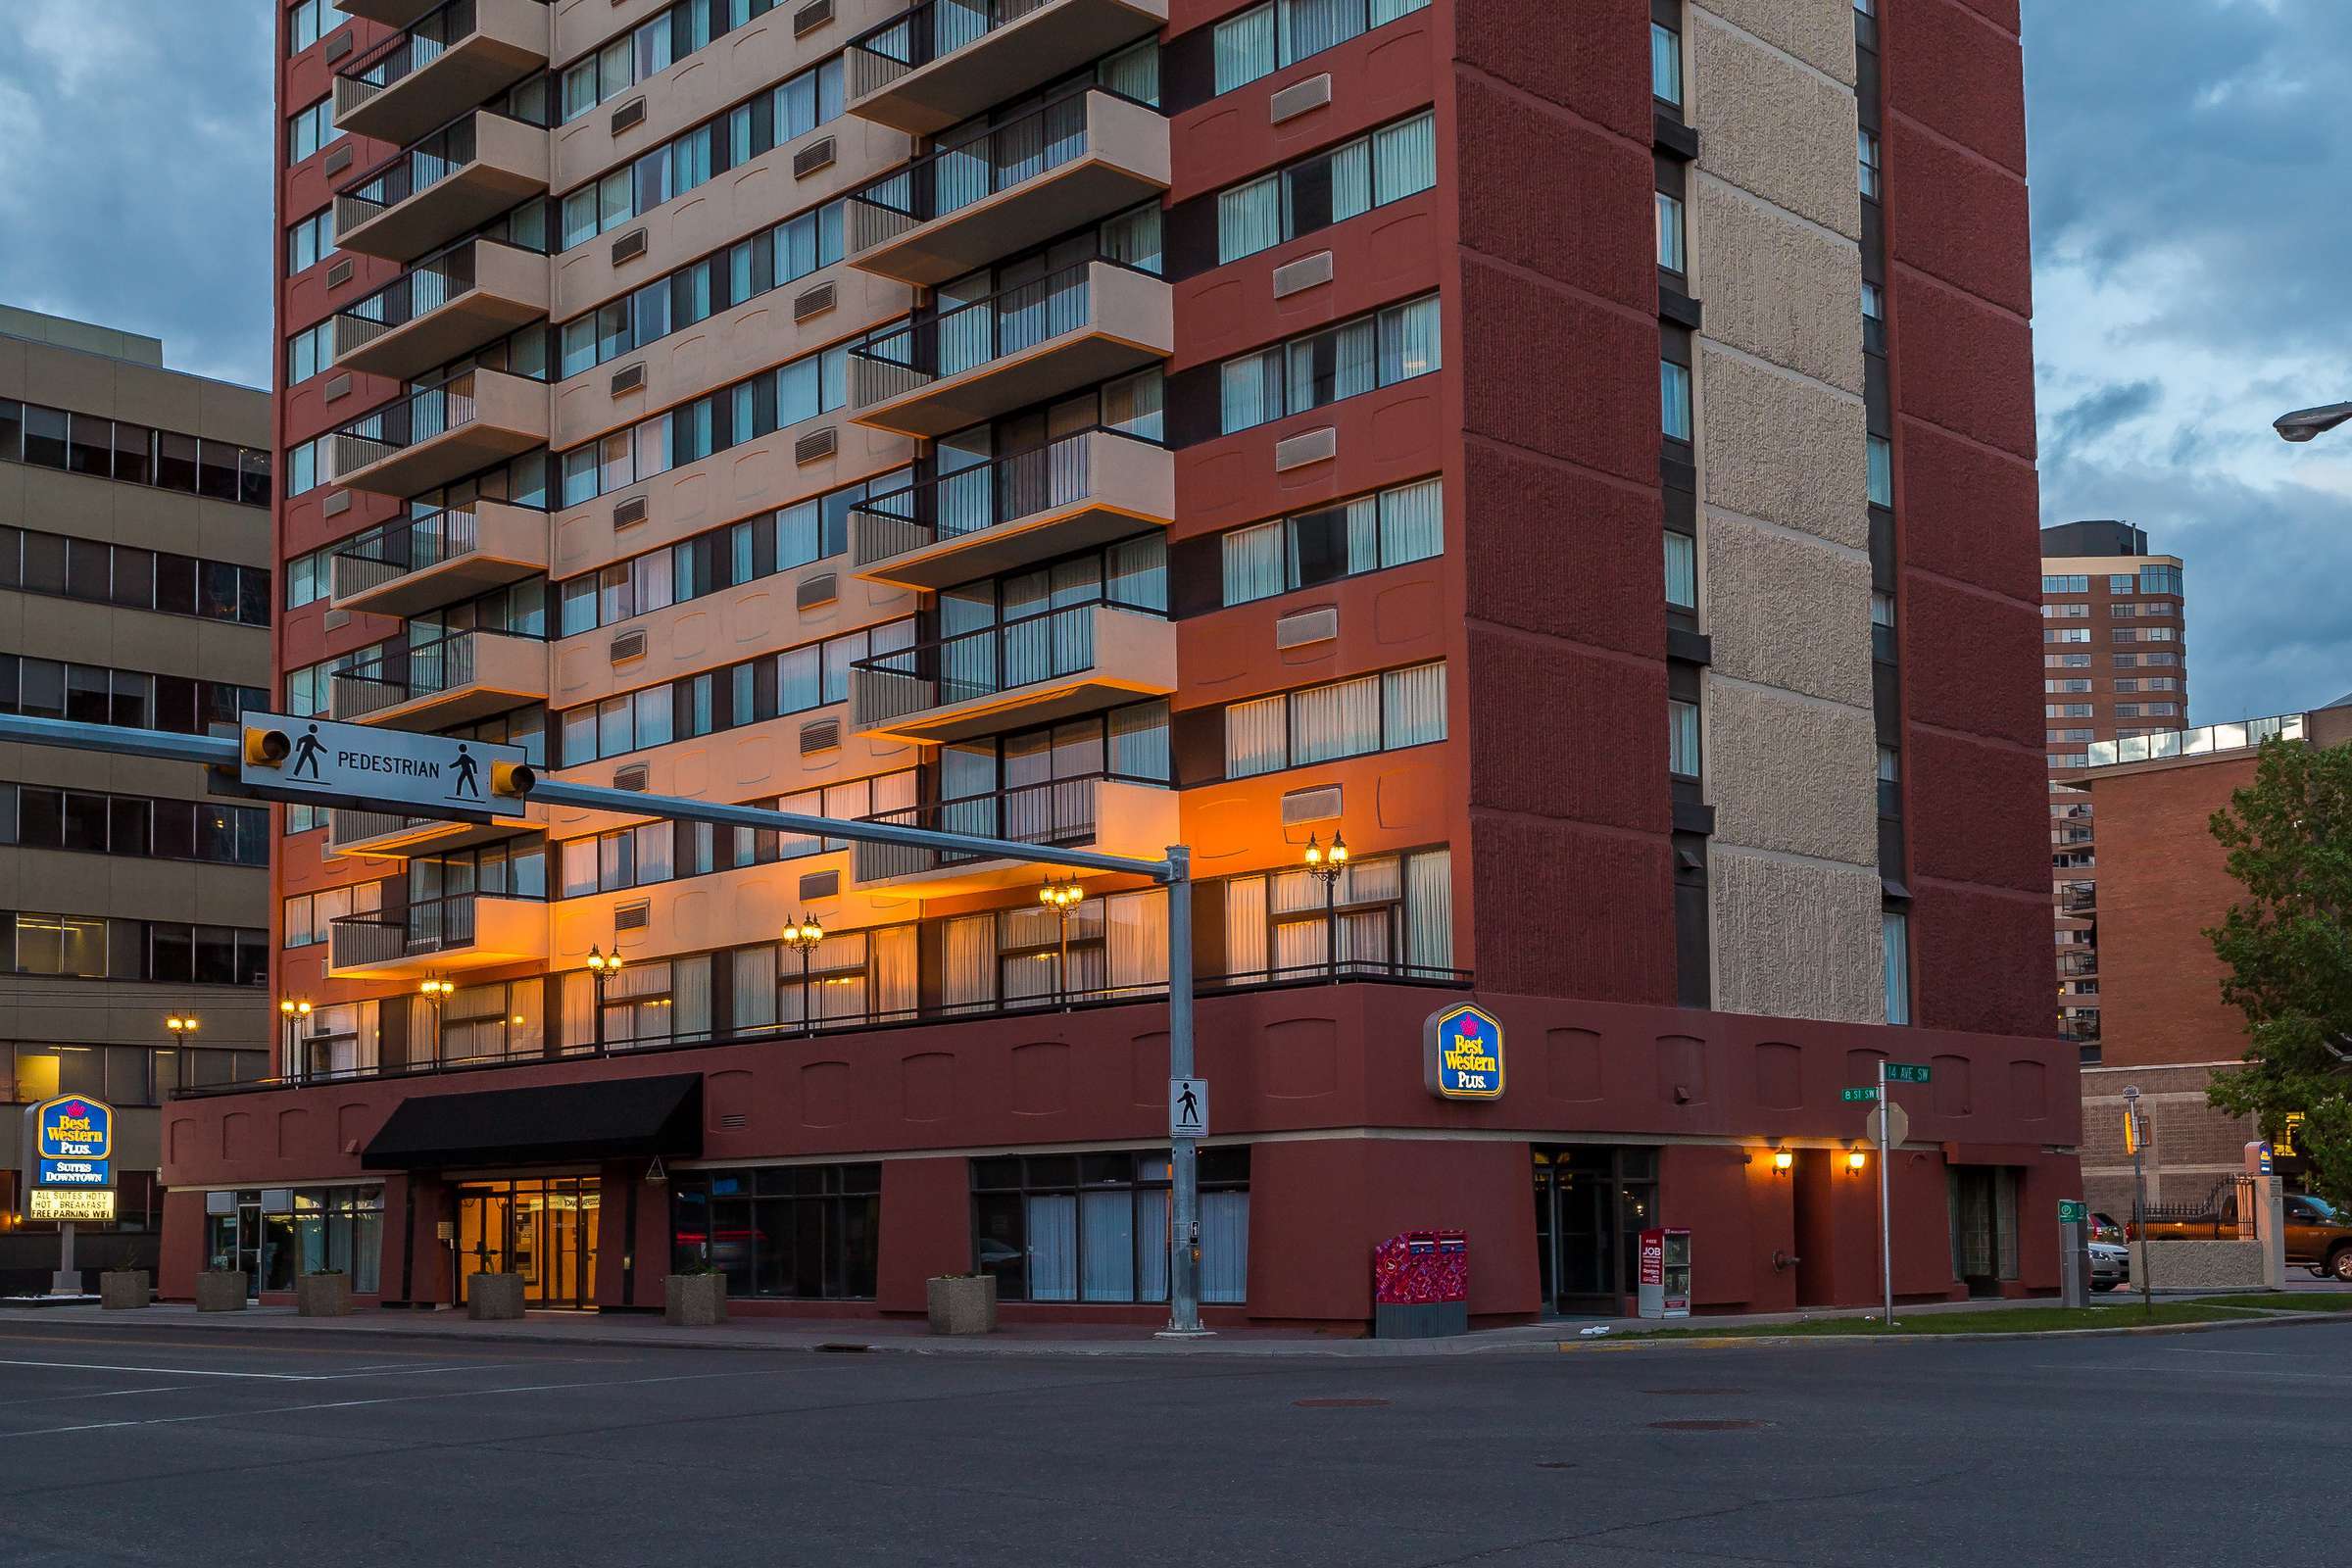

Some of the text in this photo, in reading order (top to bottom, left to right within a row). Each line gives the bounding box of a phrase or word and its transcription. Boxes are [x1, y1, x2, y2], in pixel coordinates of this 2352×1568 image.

[338, 751, 440, 779] PEDESTRIAN
[1454, 1035, 1484, 1054] Best
[1444, 1051, 1496, 1071] Western
[1887, 1065, 1929, 1081] 14 AVE SW
[1844, 1091, 1851, 1100] 8
[1864, 1089, 1875, 1099] SW
[60, 1115, 90, 1130] Best
[47, 1127, 103, 1142] Western
[57, 1162, 91, 1172] SUITES
[46, 1171, 102, 1182] DOWNTOWN
[31, 1209, 51, 1218] FREE
[54, 1209, 89, 1218] PARKING
[1642, 1247, 1661, 1255] JOB
